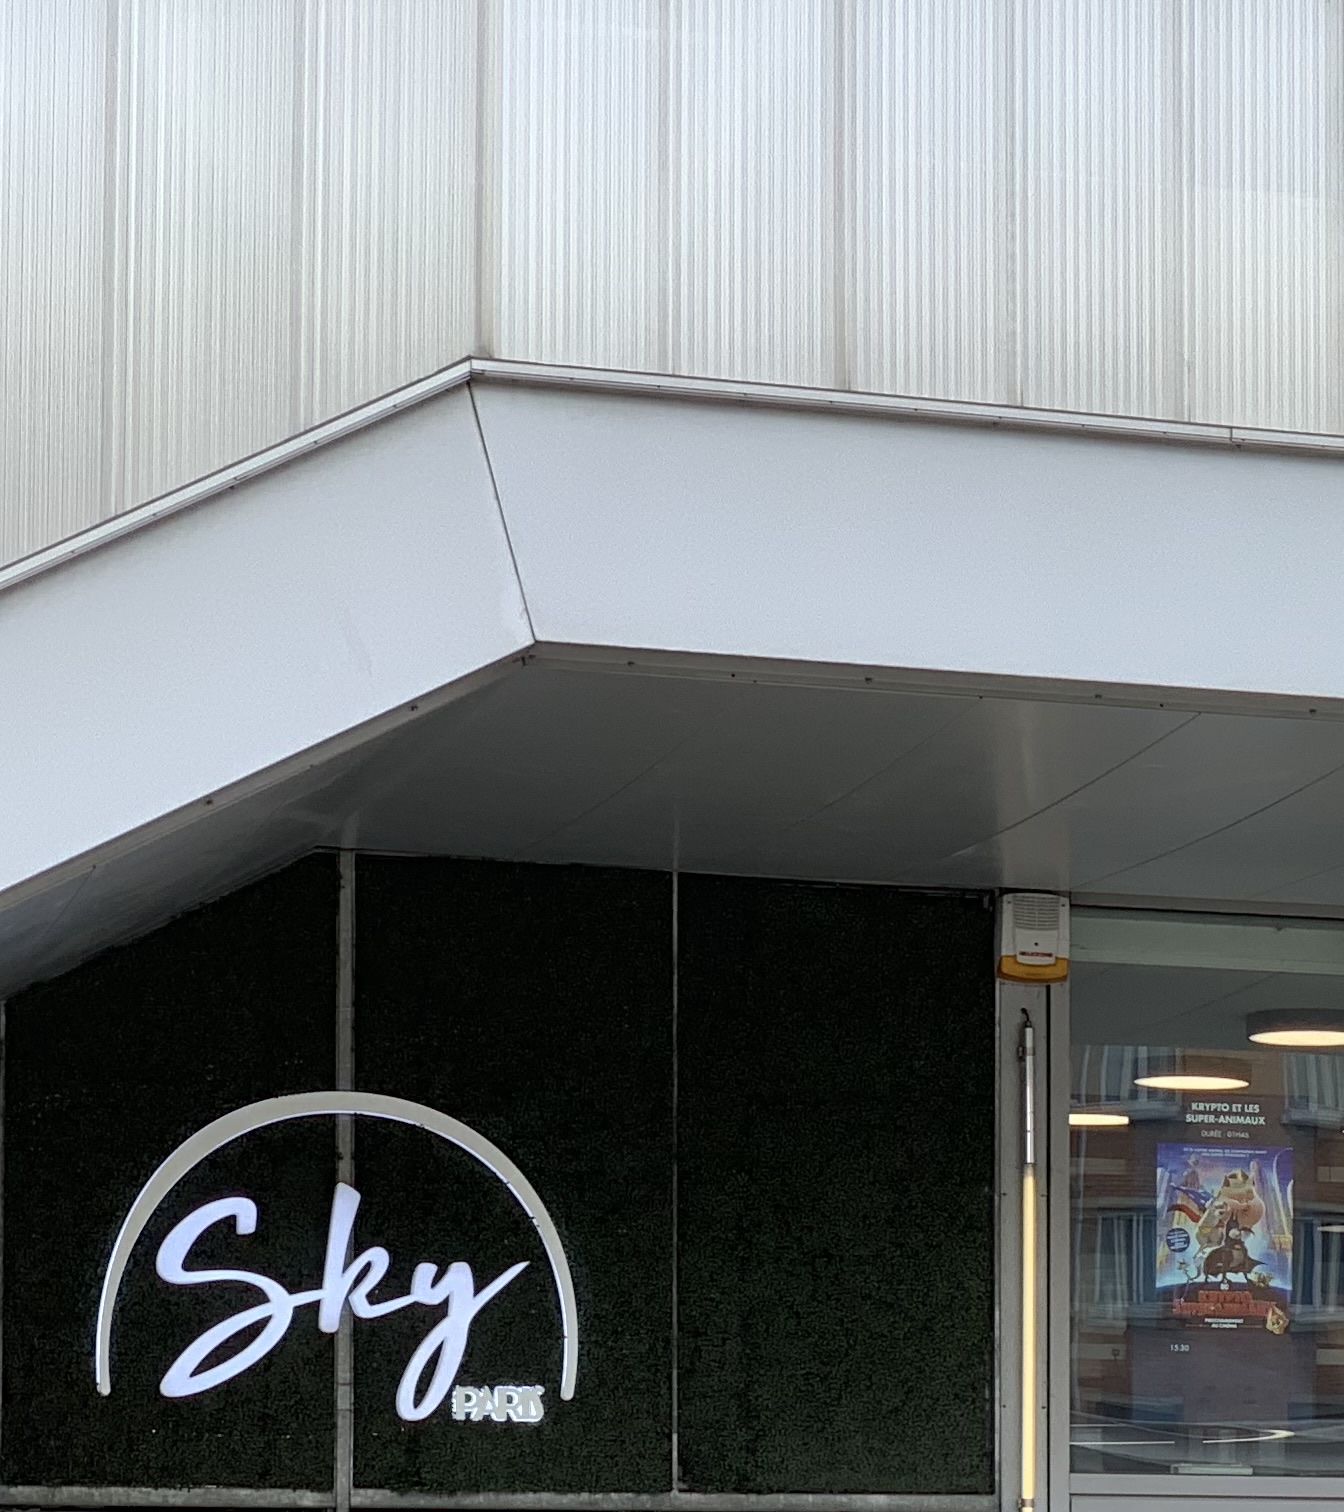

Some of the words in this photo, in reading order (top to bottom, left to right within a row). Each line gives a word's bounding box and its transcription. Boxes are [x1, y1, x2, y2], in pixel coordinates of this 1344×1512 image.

[1191, 1102, 1230, 1112] KRYPTO
[1232, 1103, 1243, 1113] ET
[1244, 1104, 1260, 1114] LES
[1186, 1114, 1266, 1126] SUPER-ANIMAUX
[155, 1181, 530, 1422] Sky
